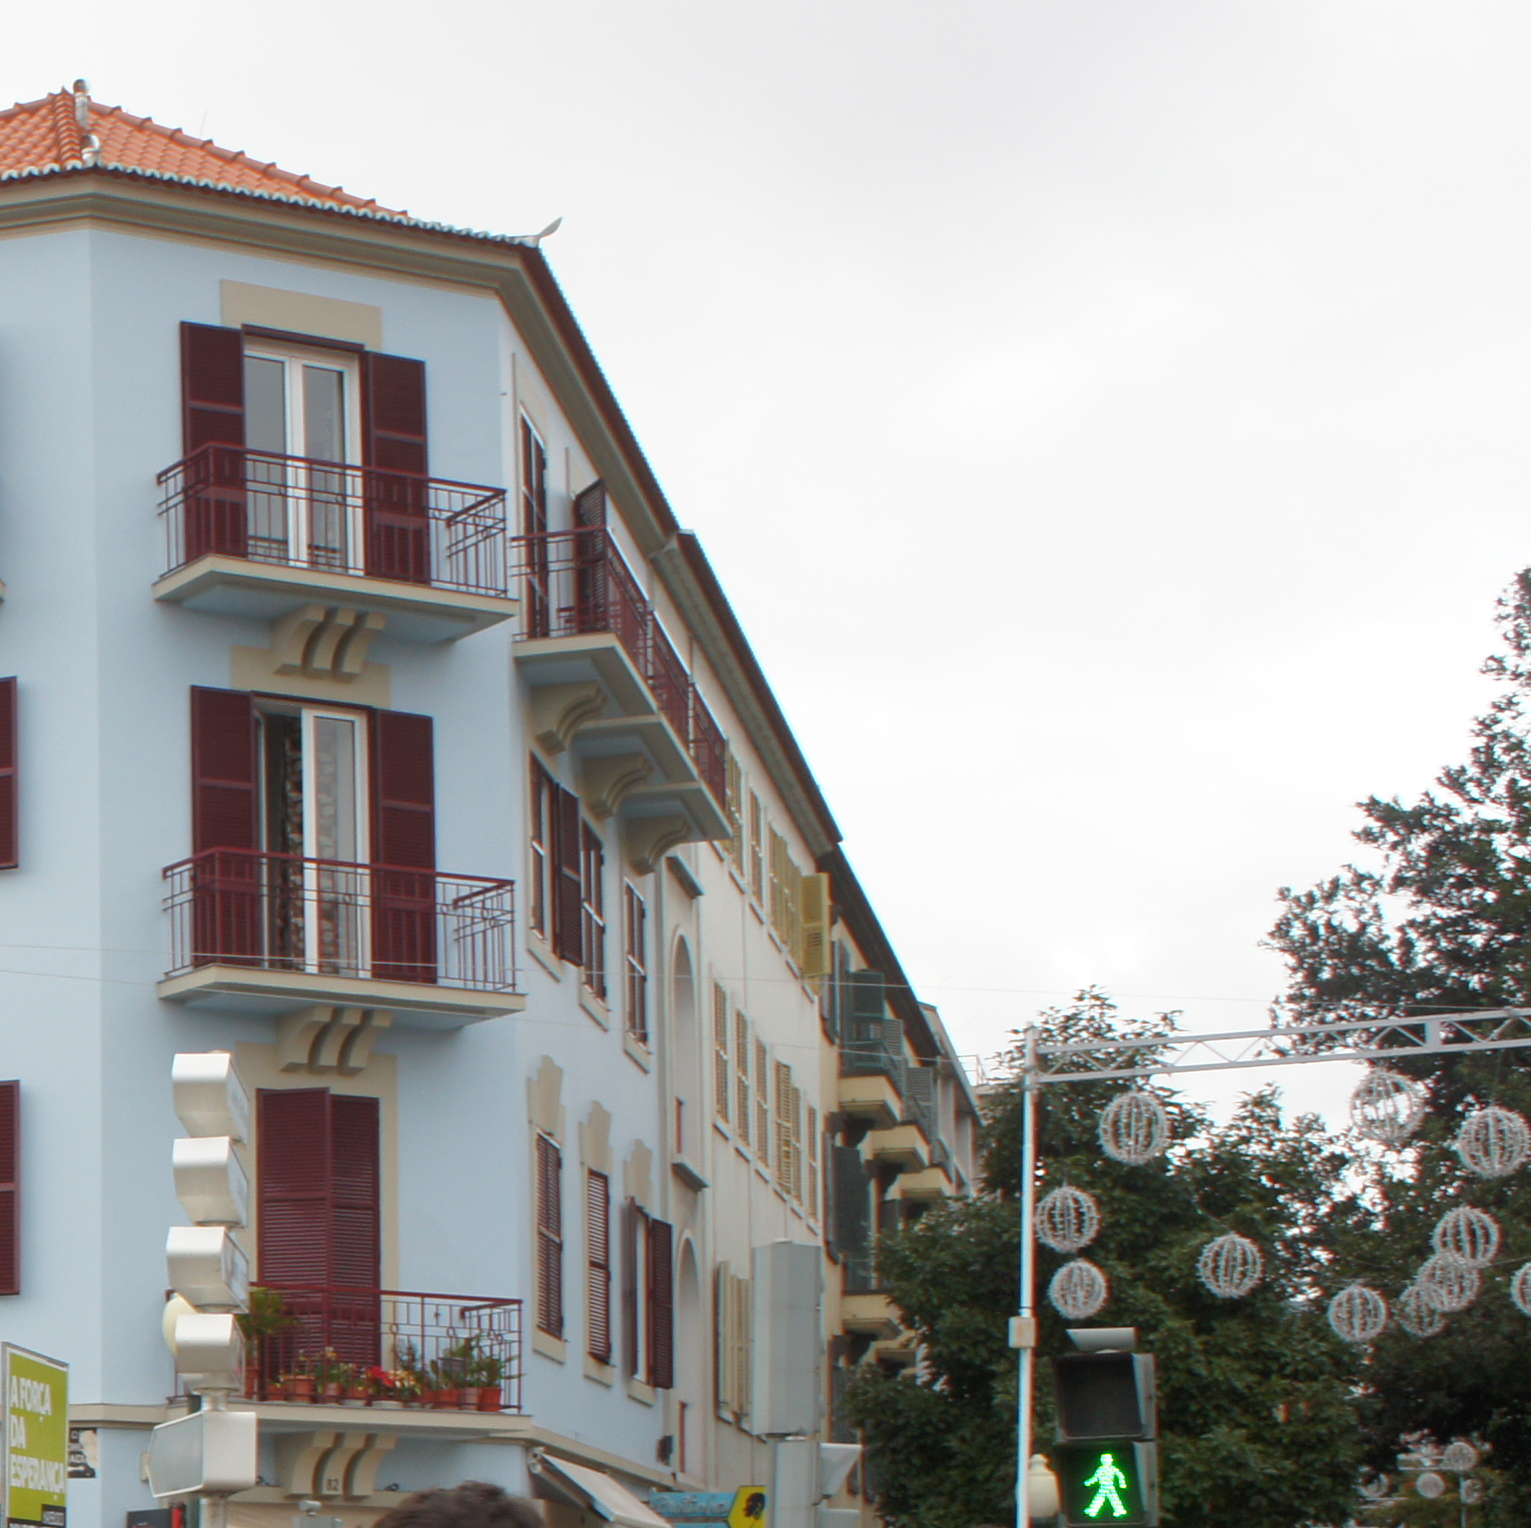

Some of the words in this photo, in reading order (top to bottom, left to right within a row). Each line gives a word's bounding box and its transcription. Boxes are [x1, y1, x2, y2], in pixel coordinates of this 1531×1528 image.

[19, 1377, 52, 1423] FORÇA
[11, 1414, 27, 1449] DA
[10, 1453, 66, 1501] ESPERANÇA
